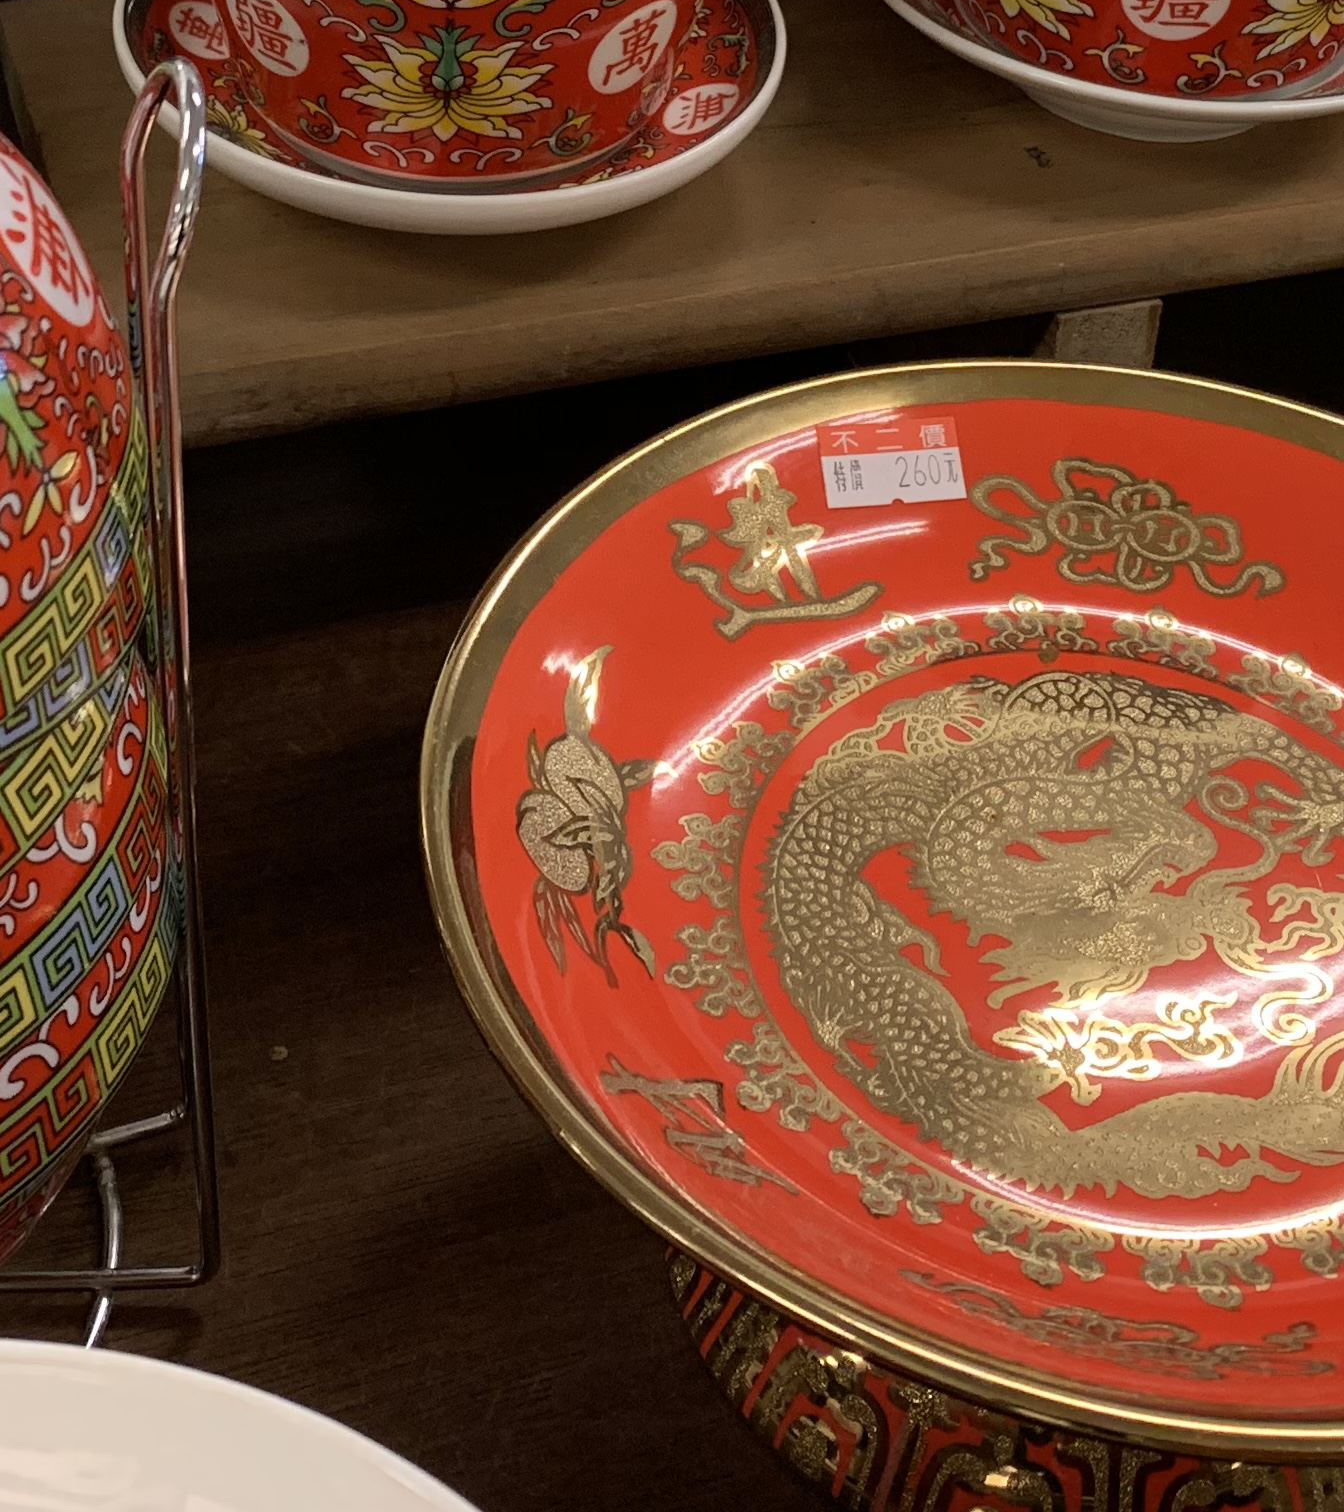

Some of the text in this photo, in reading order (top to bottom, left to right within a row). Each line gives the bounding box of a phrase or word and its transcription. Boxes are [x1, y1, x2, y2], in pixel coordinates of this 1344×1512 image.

[605, 11, 665, 86] 萬
[829, 423, 948, 455] 不二價
[832, 451, 959, 493] 特價 260元
